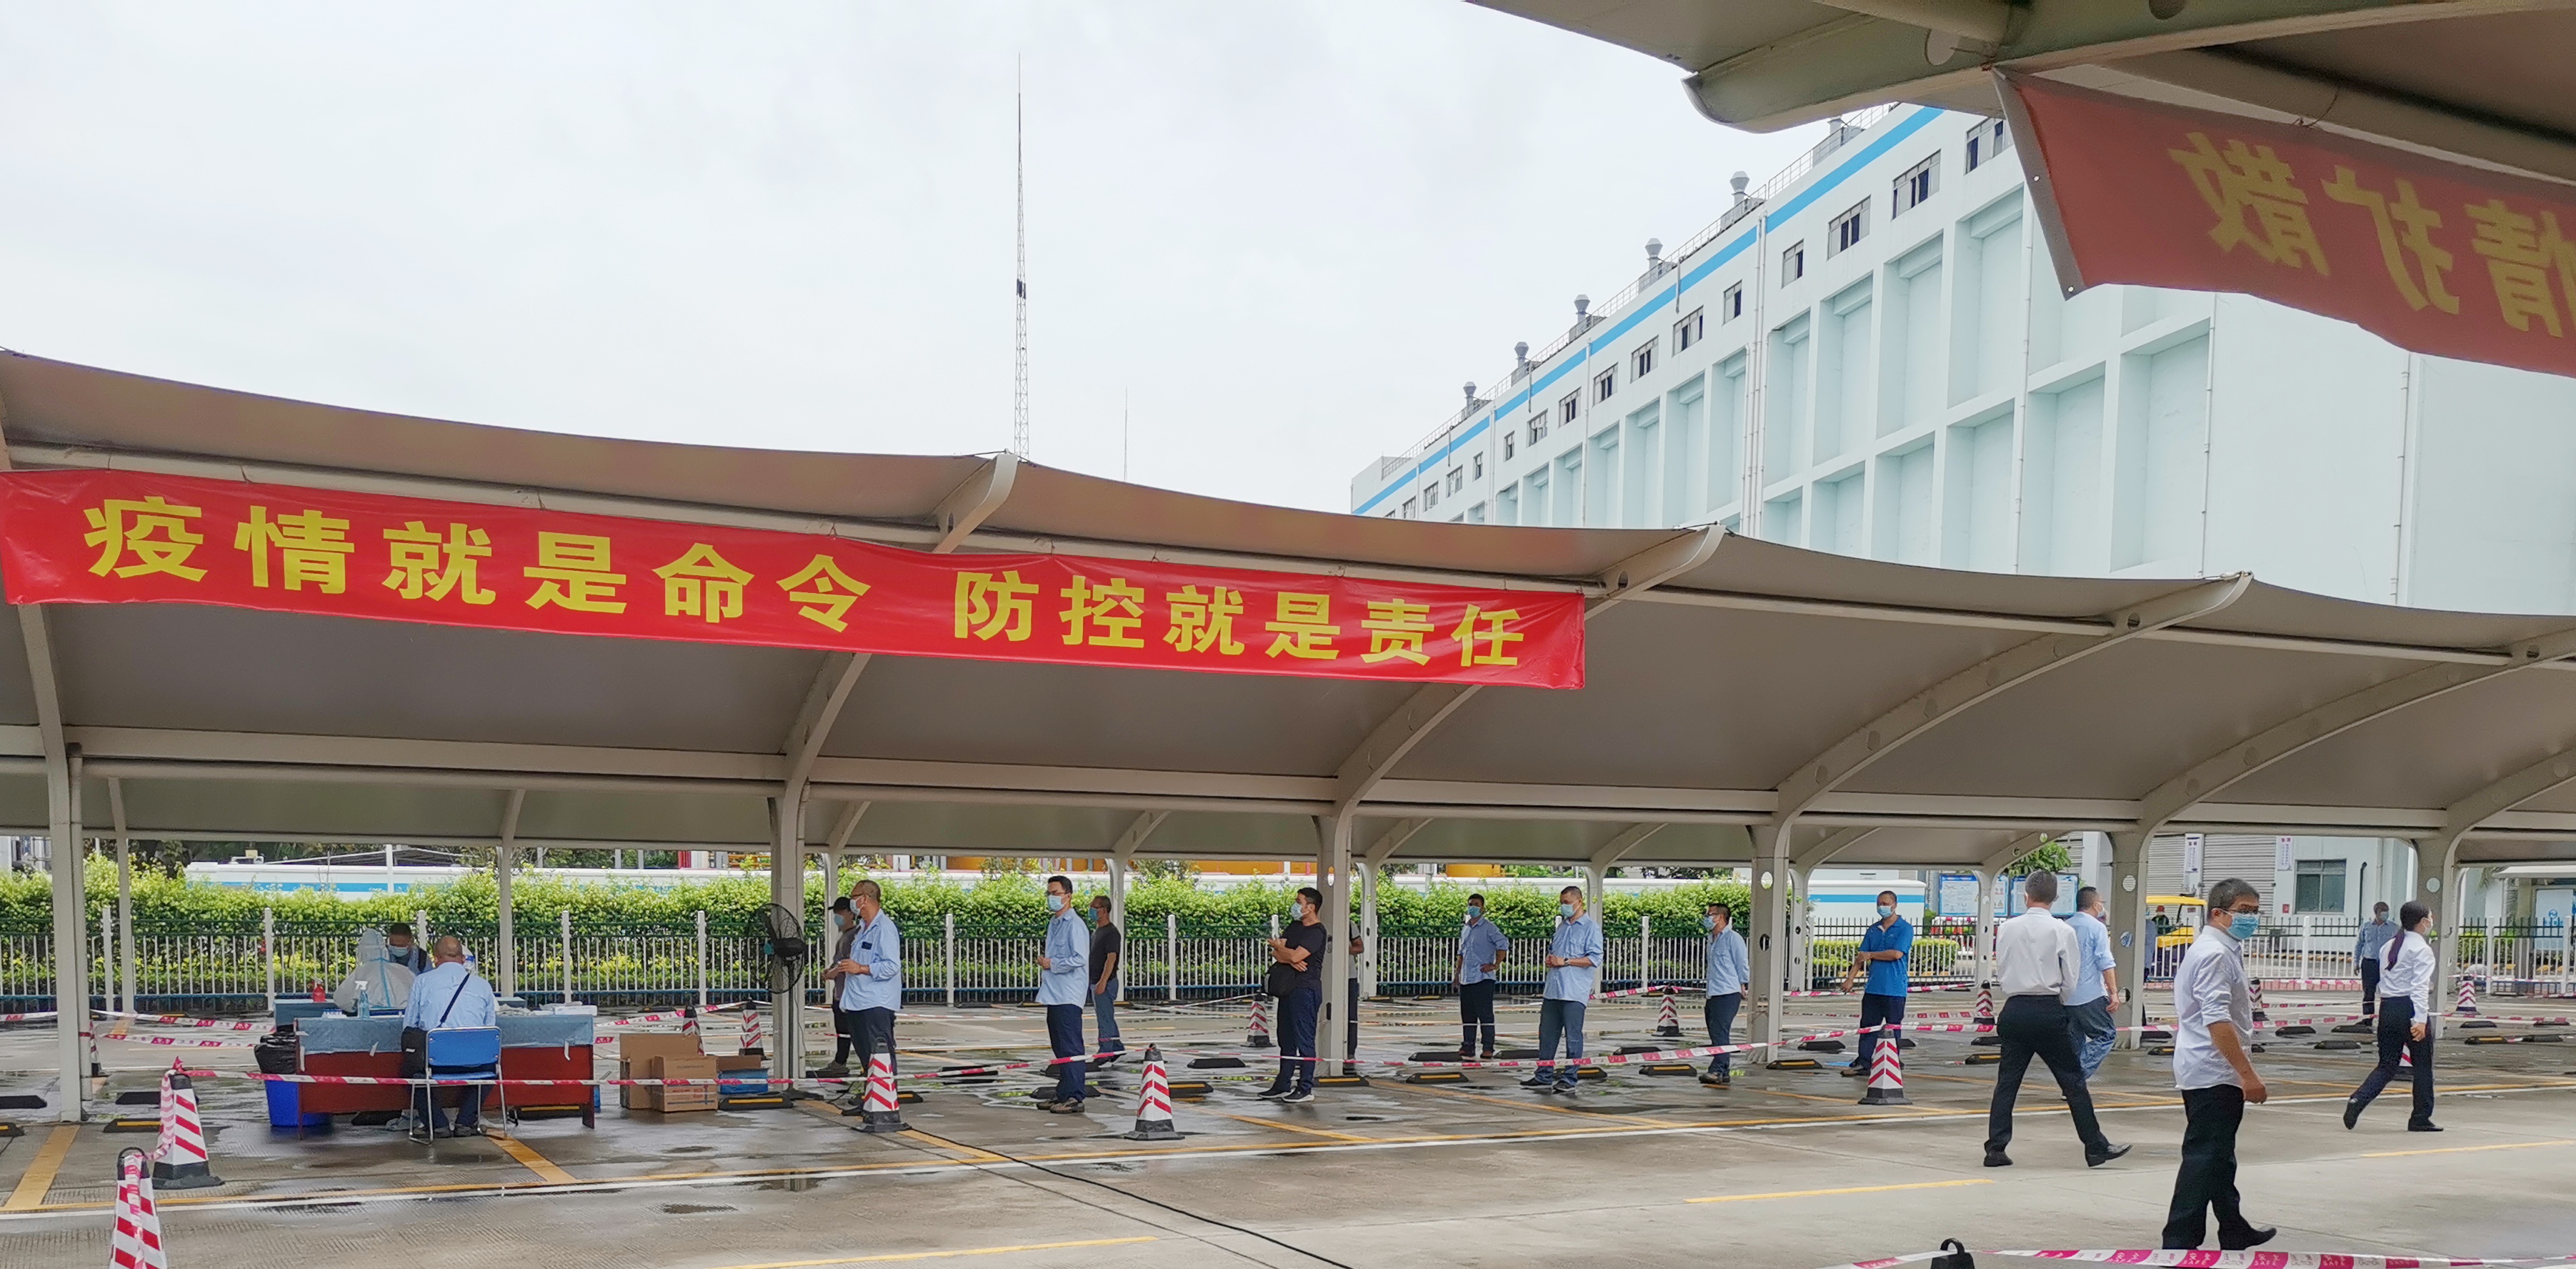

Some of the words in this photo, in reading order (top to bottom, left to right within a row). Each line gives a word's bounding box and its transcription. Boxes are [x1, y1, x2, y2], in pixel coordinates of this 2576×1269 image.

[84, 496, 872, 632] 疫情就是命令
[954, 571, 1524, 667] 防控就是责任
